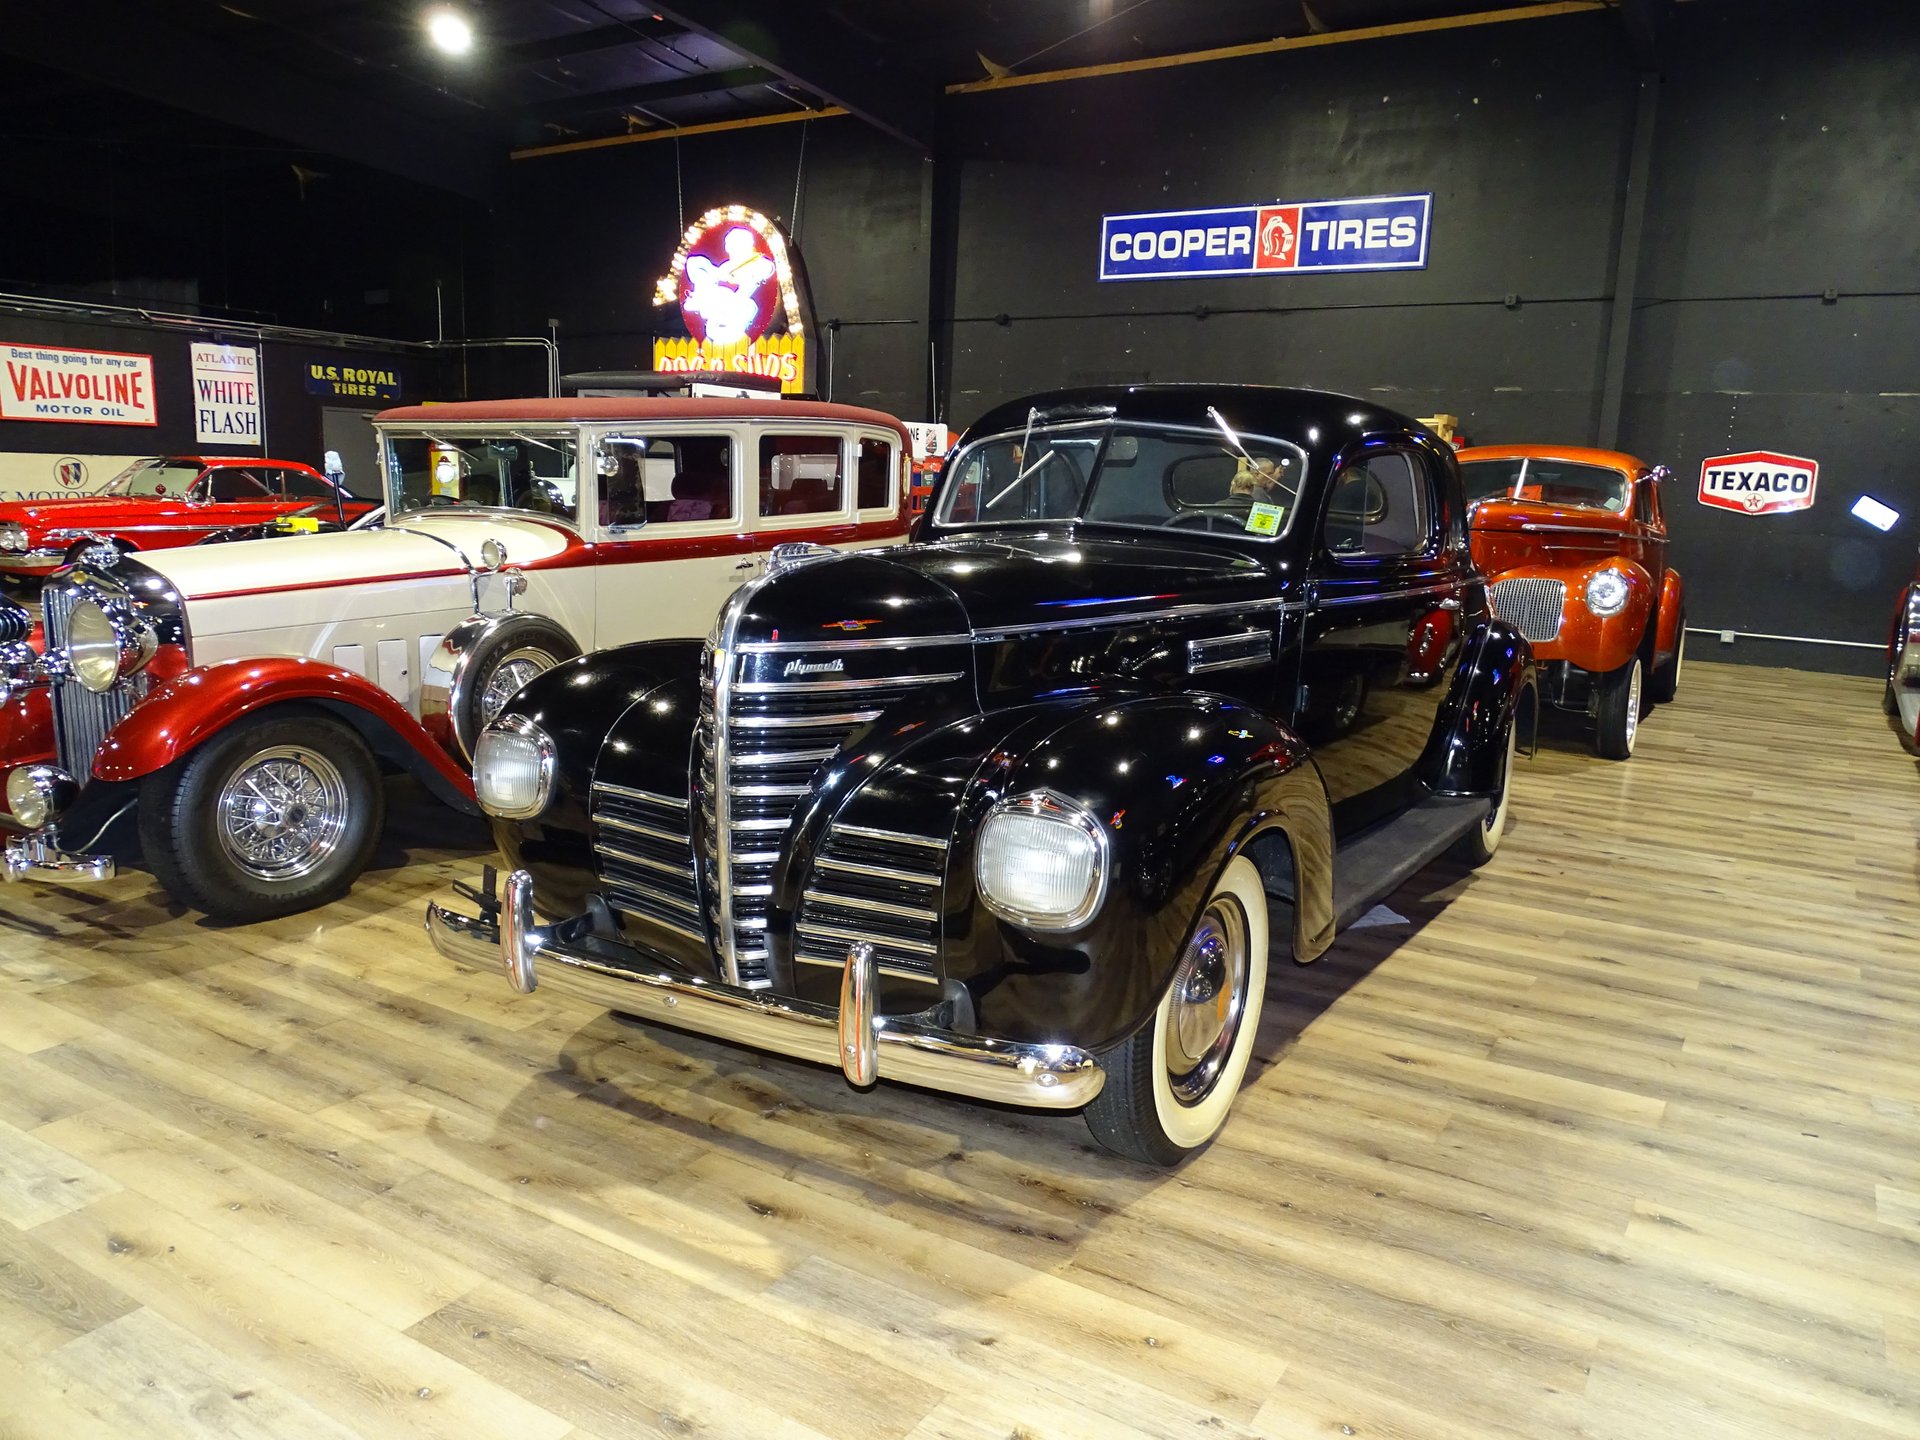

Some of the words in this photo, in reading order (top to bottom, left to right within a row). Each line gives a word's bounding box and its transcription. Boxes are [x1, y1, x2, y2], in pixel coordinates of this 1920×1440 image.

[1109, 225, 1251, 262] COOPER
[1305, 215, 1417, 251] TIRES
[11, 348, 33, 359] Best
[35, 350, 59, 364] thing
[62, 353, 88, 366] going
[90, 355, 103, 365] for
[106, 358, 122, 368] any
[124, 360, 137, 368] car
[196, 352, 254, 366] ATLANTIC
[6, 360, 145, 410] VALVOLINE
[310, 364, 340, 381] U.S.
[342, 367, 398, 386] ROYAL
[197, 379, 256, 406] WHITE
[332, 381, 377, 397] TIRES
[36, 404, 93, 415] MOTOR
[100, 407, 125, 417] OIL
[199, 409, 257, 435] FLASH
[1708, 470, 1808, 493] TEXACO
